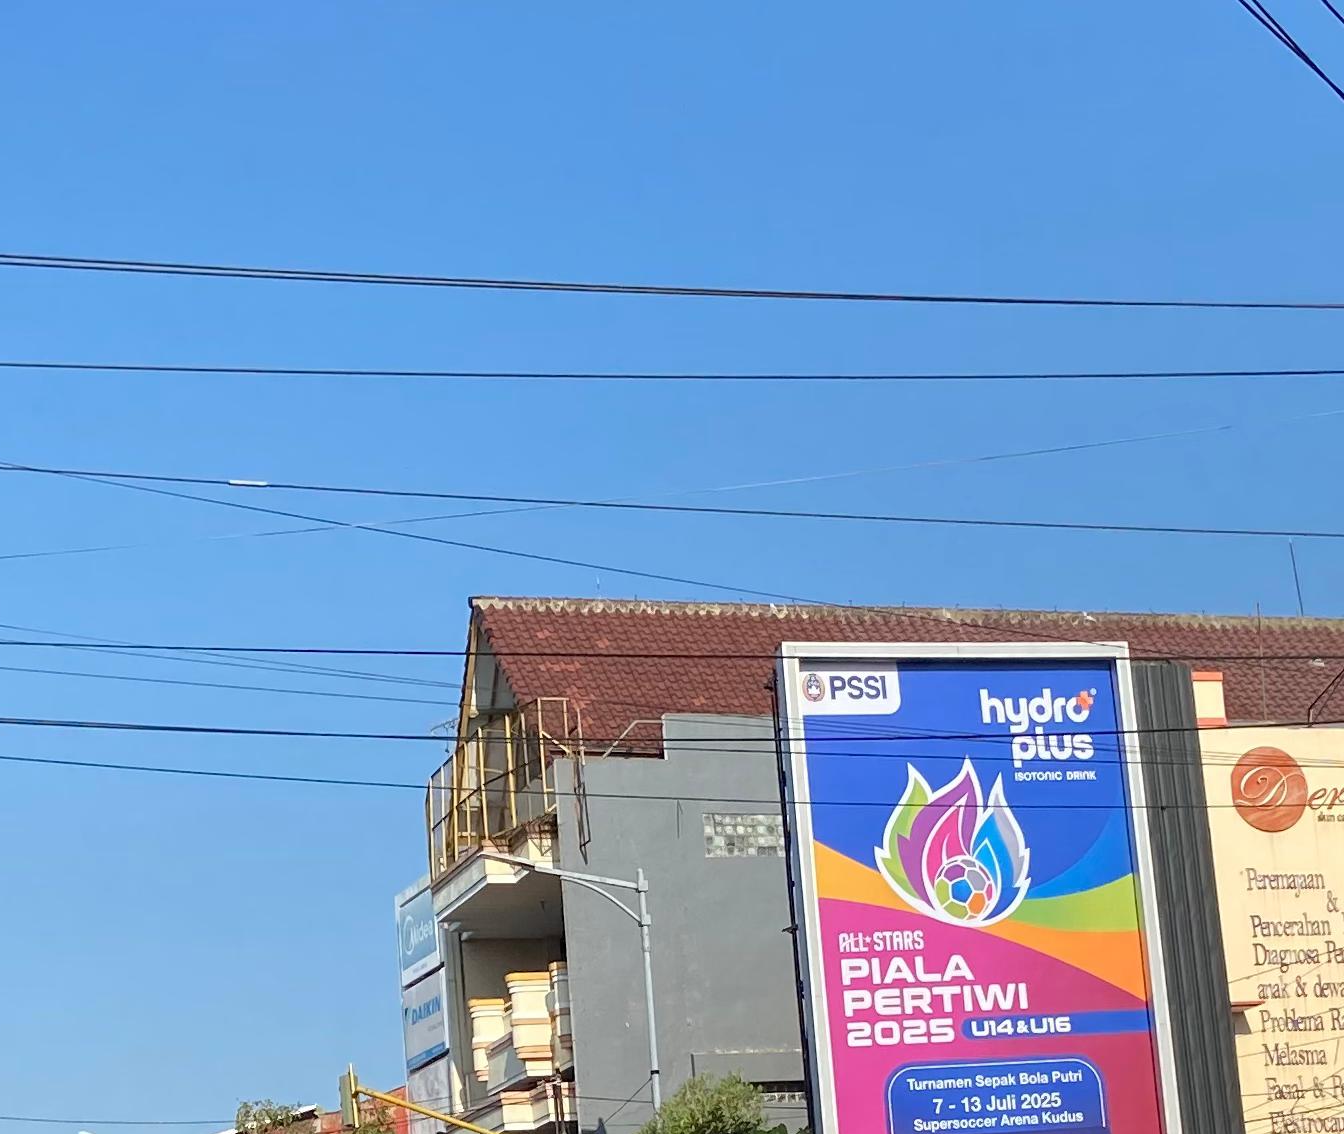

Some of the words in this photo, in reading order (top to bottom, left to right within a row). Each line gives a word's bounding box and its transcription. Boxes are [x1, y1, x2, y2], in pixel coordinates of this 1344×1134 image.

[829, 675, 888, 700] PSSI
[979, 687, 1093, 734] hydro
[1011, 726, 1094, 768] plus
[1014, 770, 1063, 782] ISOTONIC
[1066, 770, 1096, 781] DRINK
[1246, 867, 1325, 897] Peremajaan
[1326, 890, 1339, 913] &
[1250, 913, 1331, 938] Pencerahan
[873, 930, 925, 952] STARS
[840, 954, 975, 986] PIALA
[1253, 943, 1320, 973] Diagnosa
[843, 982, 1029, 1017] PERTIWI
[1257, 978, 1289, 1000] anak
[1295, 975, 1307, 999] &
[411, 995, 441, 1025] DAIKIN
[1259, 1008, 1324, 1033] Problema
[846, 1017, 955, 1047] 2025
[1264, 1041, 1327, 1067] Melasma
[907, 1077, 972, 1091] Turnamen
[975, 1073, 1016, 1089] Sepak
[1019, 1072, 1049, 1086] Bola
[1052, 1069, 1083, 1083] Putri
[1312, 1080, 1324, 1099] &
[932, 1098, 943, 1114] 7
[961, 1096, 981, 1113] 13
[986, 1094, 1016, 1112] Juli
[1021, 1091, 1061, 1109] 2025
[913, 1116, 997, 1133] Supersoccer
[1000, 1112, 1039, 1127] Arena
[1042, 1110, 1083, 1124] Kudus
